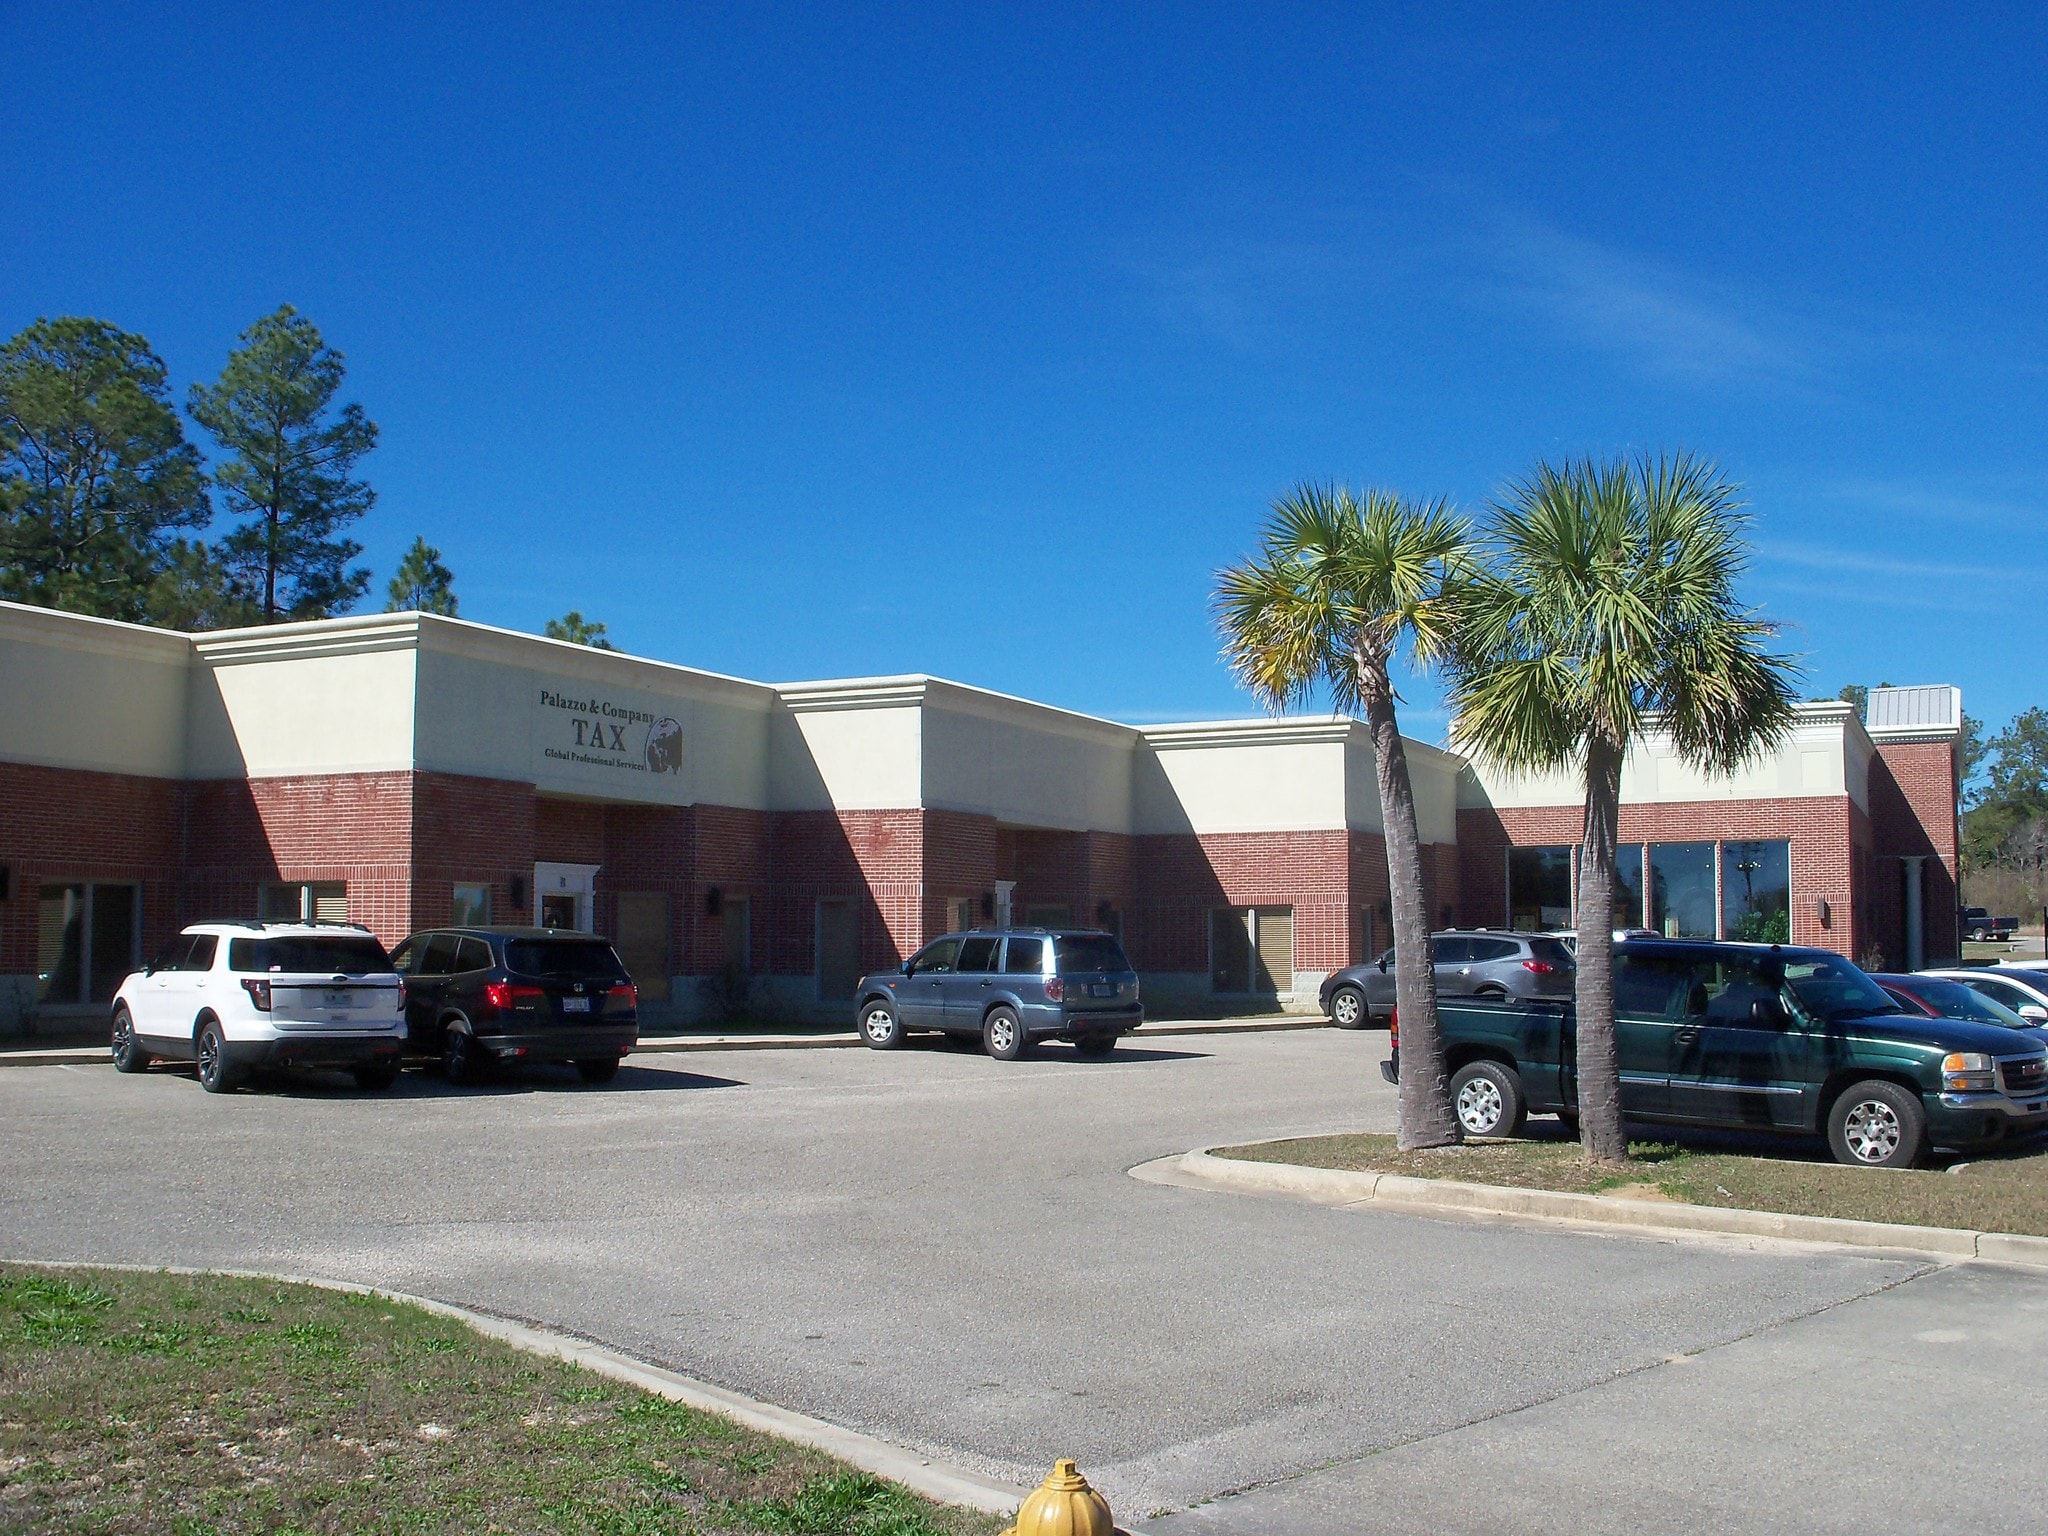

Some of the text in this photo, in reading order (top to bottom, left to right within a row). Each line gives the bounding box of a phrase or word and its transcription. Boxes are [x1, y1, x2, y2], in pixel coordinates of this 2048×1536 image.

[540, 690, 655, 728] Palazzo & Company
[571, 718, 626, 752] TAX
[544, 748, 645, 771] Global Professional Services
